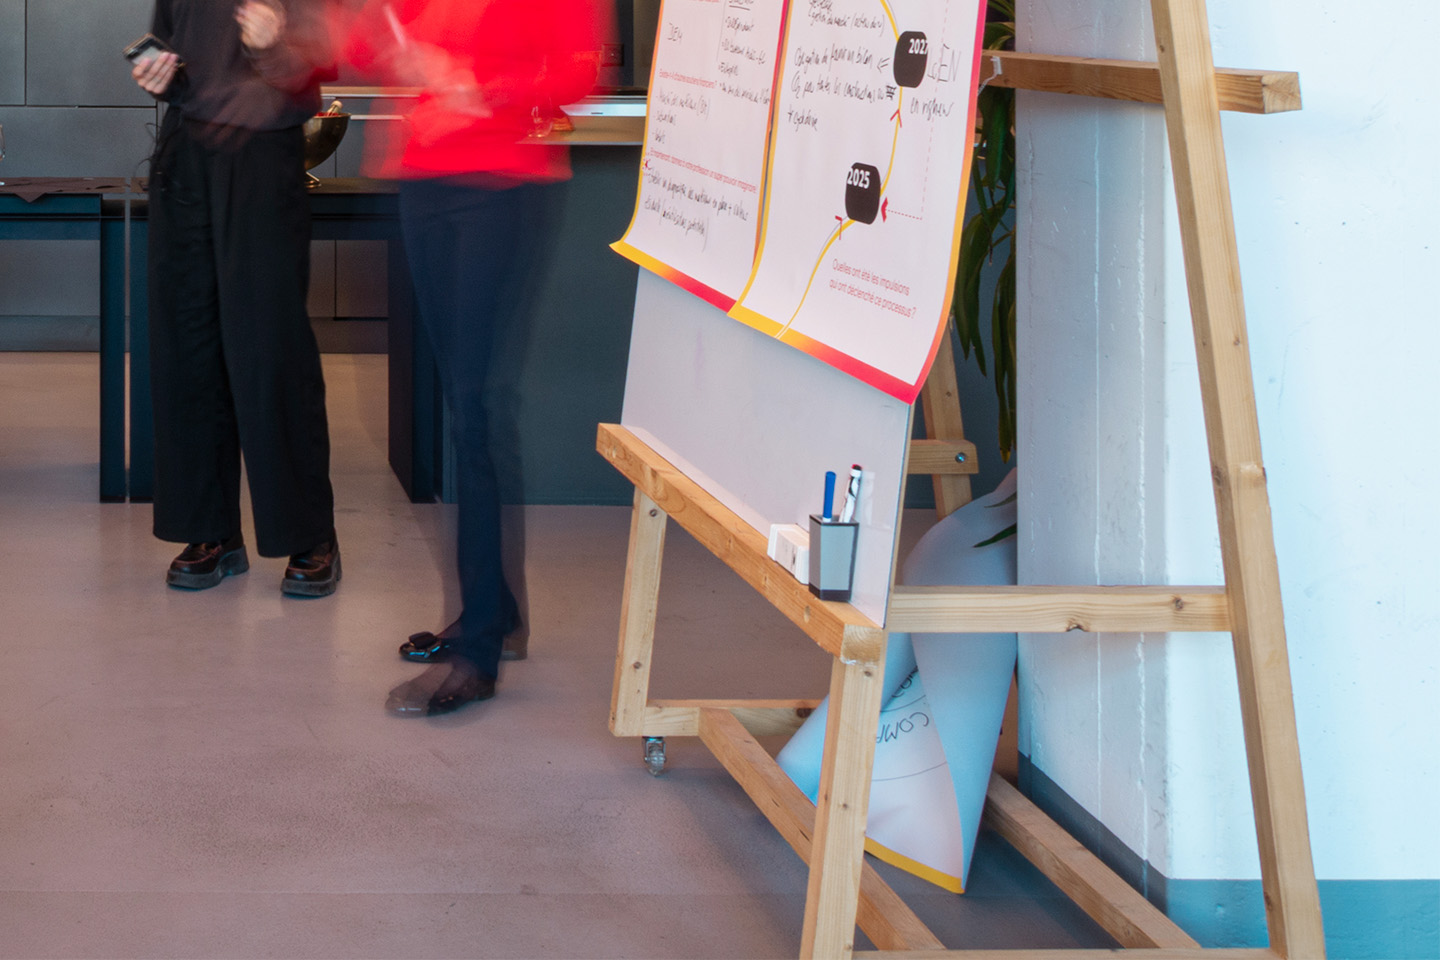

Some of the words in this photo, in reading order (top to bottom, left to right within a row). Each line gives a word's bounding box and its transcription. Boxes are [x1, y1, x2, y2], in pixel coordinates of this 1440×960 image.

[847, 167, 871, 189] 2025
[833, 258, 851, 275] Quelles
[852, 268, 861, 278] ont
[871, 273, 879, 285] les
[880, 275, 909, 296] impulsions
[829, 279, 837, 289] qui
[837, 282, 846, 292] ont
[882, 299, 911, 318] processus
